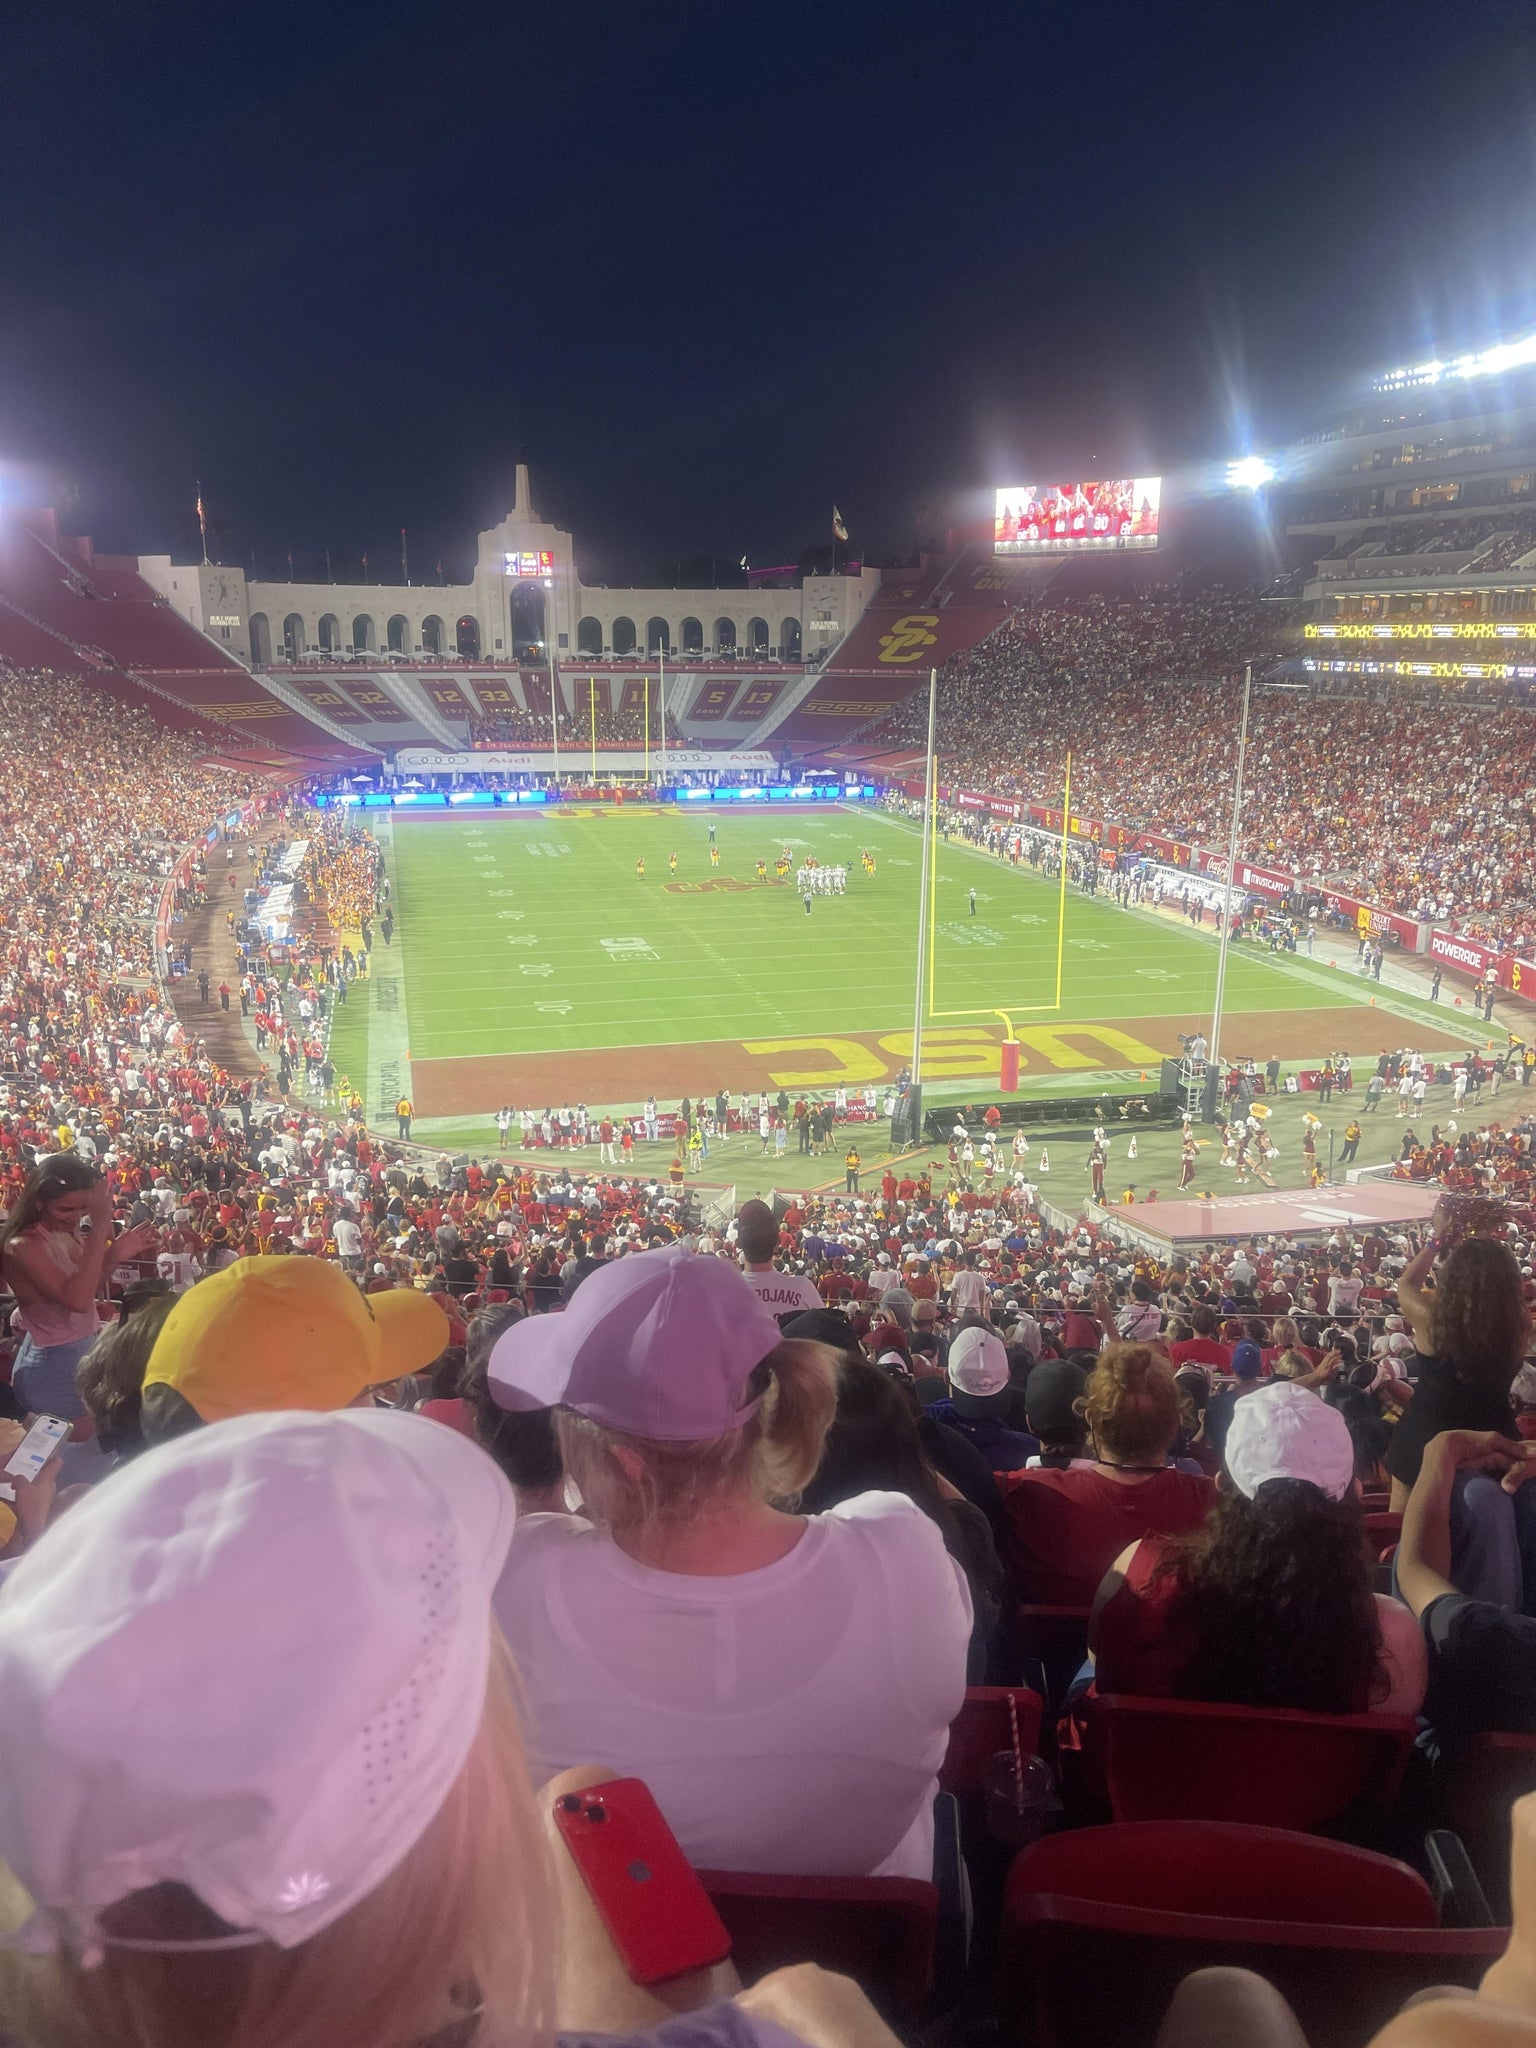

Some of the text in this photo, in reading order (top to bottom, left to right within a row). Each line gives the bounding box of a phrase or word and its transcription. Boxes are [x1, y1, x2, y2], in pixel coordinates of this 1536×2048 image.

[306, 693, 343, 705] 20
[352, 692, 389, 704] 32
[433, 690, 462, 702] 12
[479, 690, 510, 702] 33
[707, 691, 726, 703] 5
[746, 692, 773, 704] 13
[729, 753, 770, 761] Audi
[537, 808, 720, 818] USC
[991, 802, 1013, 813] UNITED
[1432, 937, 1482, 969] POWERADE
[741, 1025, 1176, 1087] USC
[121, 1172, 127, 1184] 7
[160, 1261, 182, 1285] 21
[756, 1289, 802, 1307] OJANS
